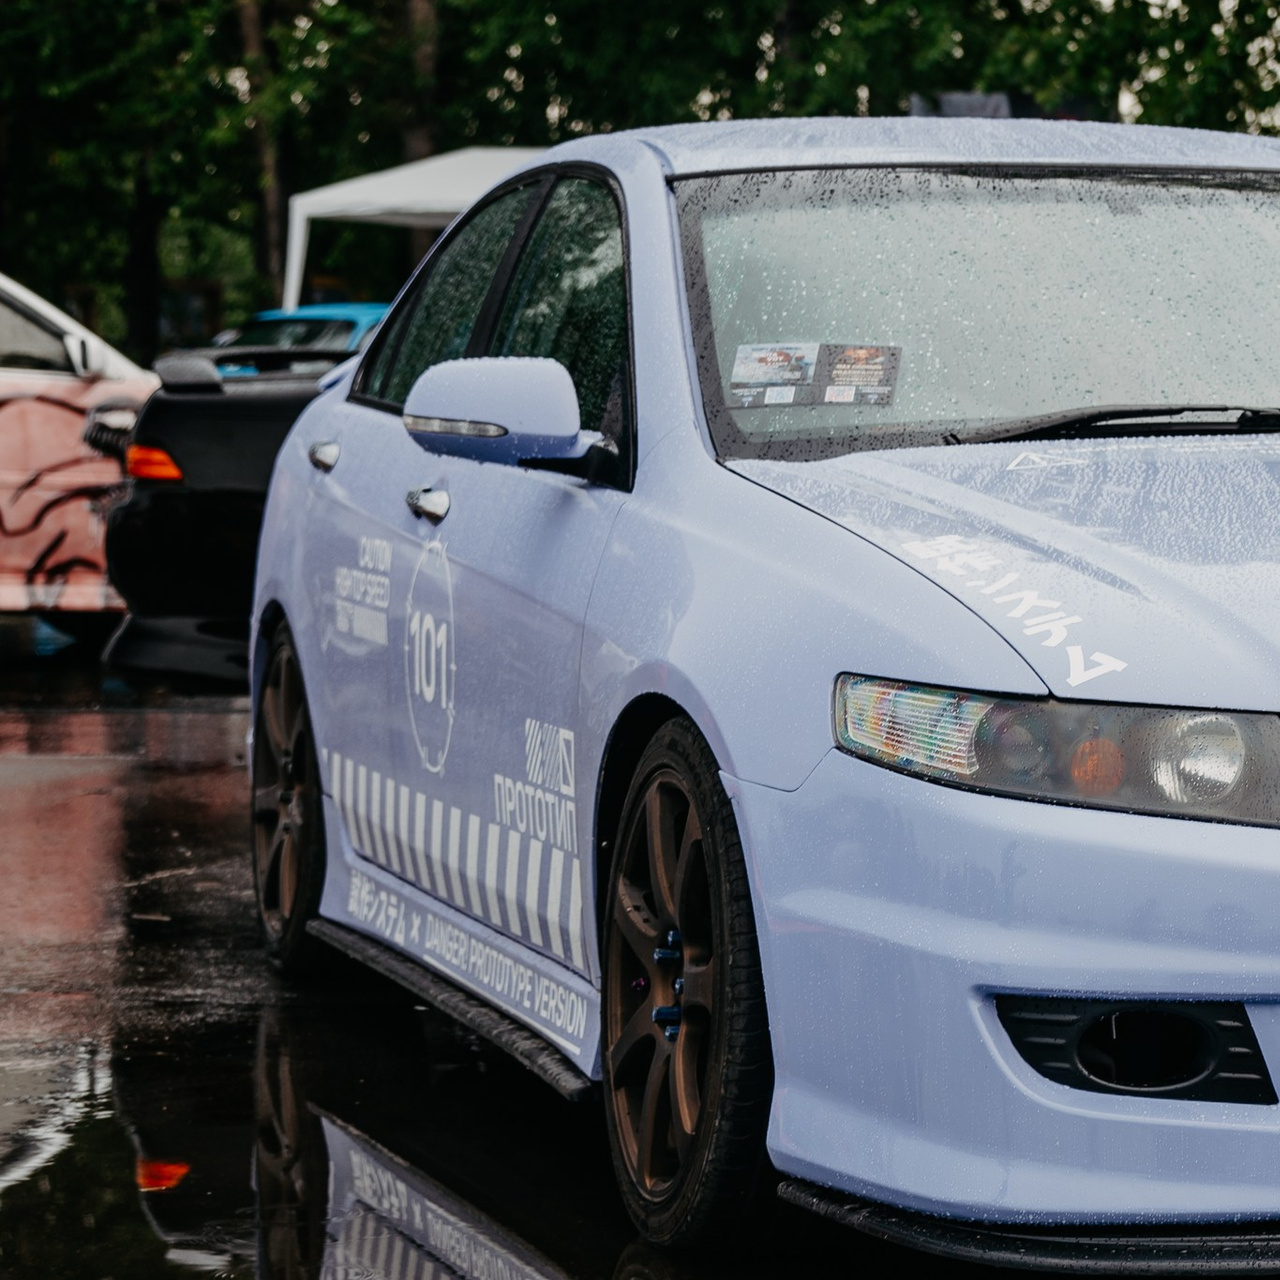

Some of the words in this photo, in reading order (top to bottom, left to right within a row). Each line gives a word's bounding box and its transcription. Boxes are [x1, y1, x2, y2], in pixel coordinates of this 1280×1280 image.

[410, 610, 447, 709] 101
[494, 773, 577, 854] ПРОТОТИП
[468, 942, 533, 1009] PROTOTYPE
[534, 972, 587, 1040] VERSION
